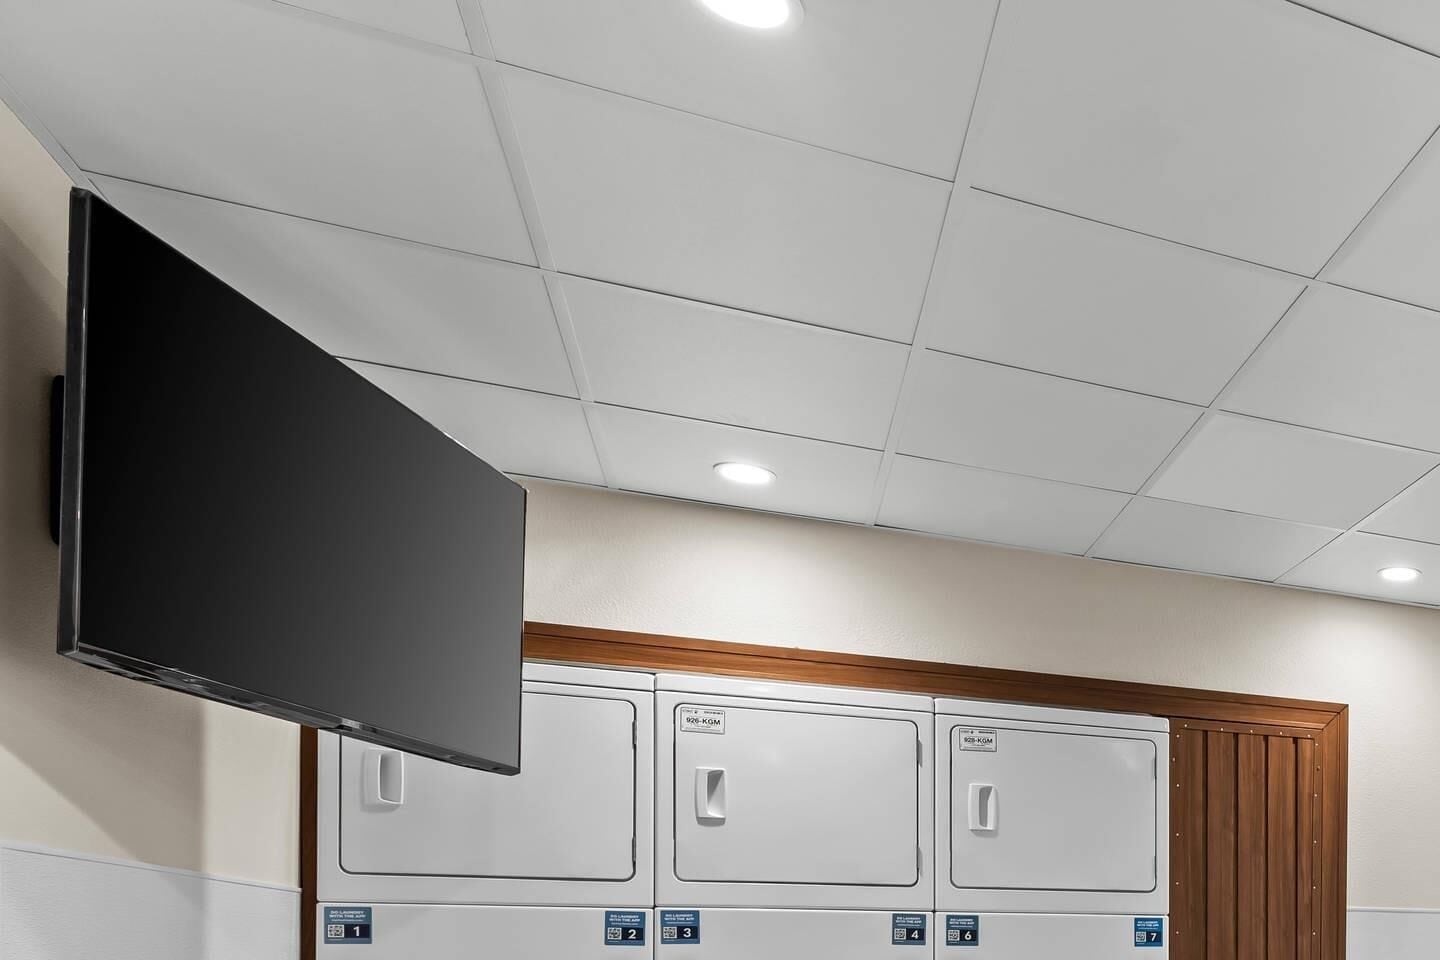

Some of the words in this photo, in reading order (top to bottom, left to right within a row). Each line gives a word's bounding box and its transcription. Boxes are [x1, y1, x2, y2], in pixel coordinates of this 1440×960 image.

[353, 926, 360, 937] 1
[628, 929, 637, 939] 2
[683, 927, 692, 938] 3
[911, 930, 919, 939] 4
[964, 931, 972, 940] 6
[1151, 933, 1157, 941] 7
